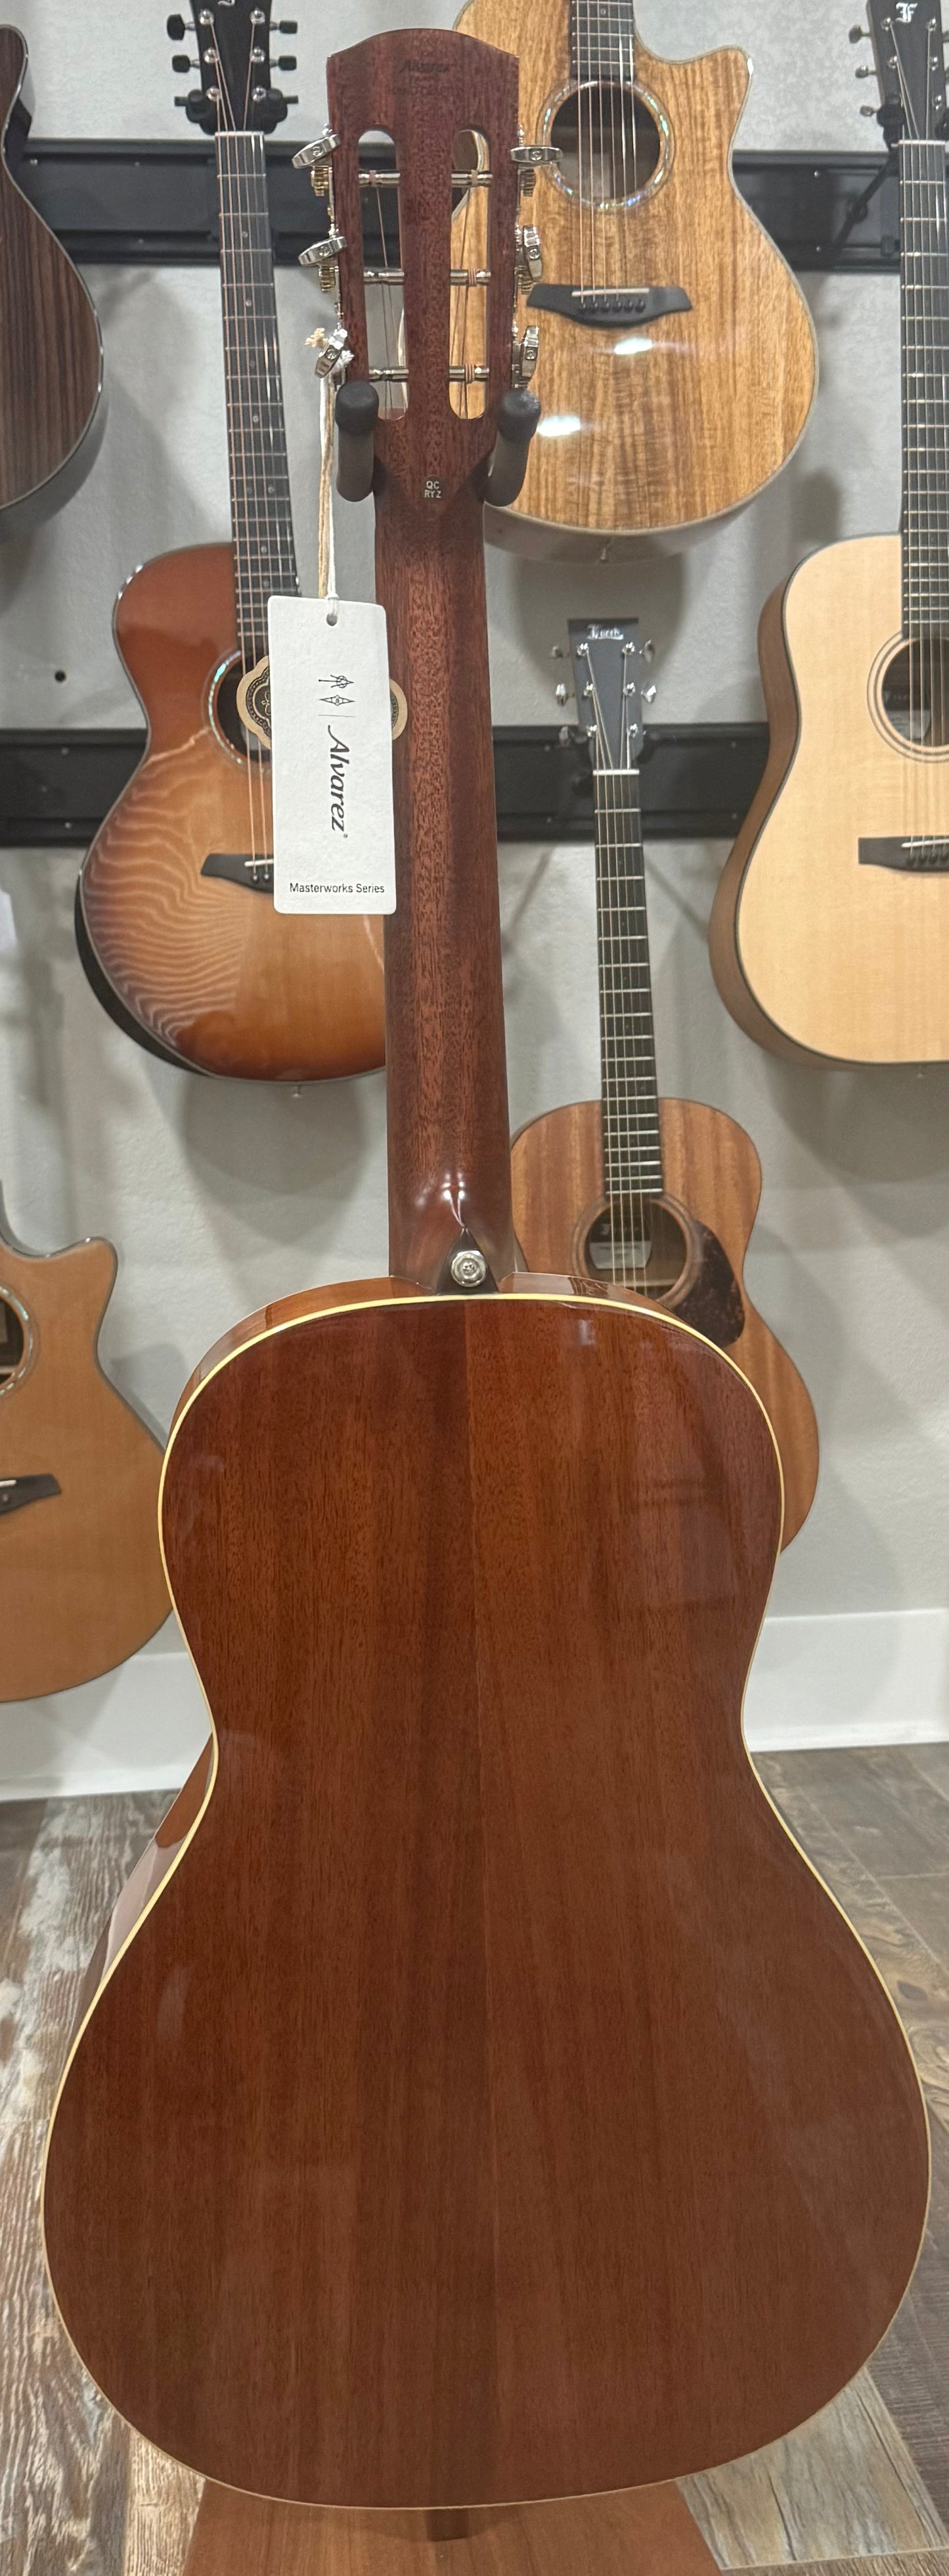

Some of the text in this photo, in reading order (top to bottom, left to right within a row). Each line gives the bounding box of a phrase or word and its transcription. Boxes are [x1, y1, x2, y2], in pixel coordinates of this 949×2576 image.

[426, 480, 439, 489] QC
[290, 882, 385, 893] Masterworks Series
